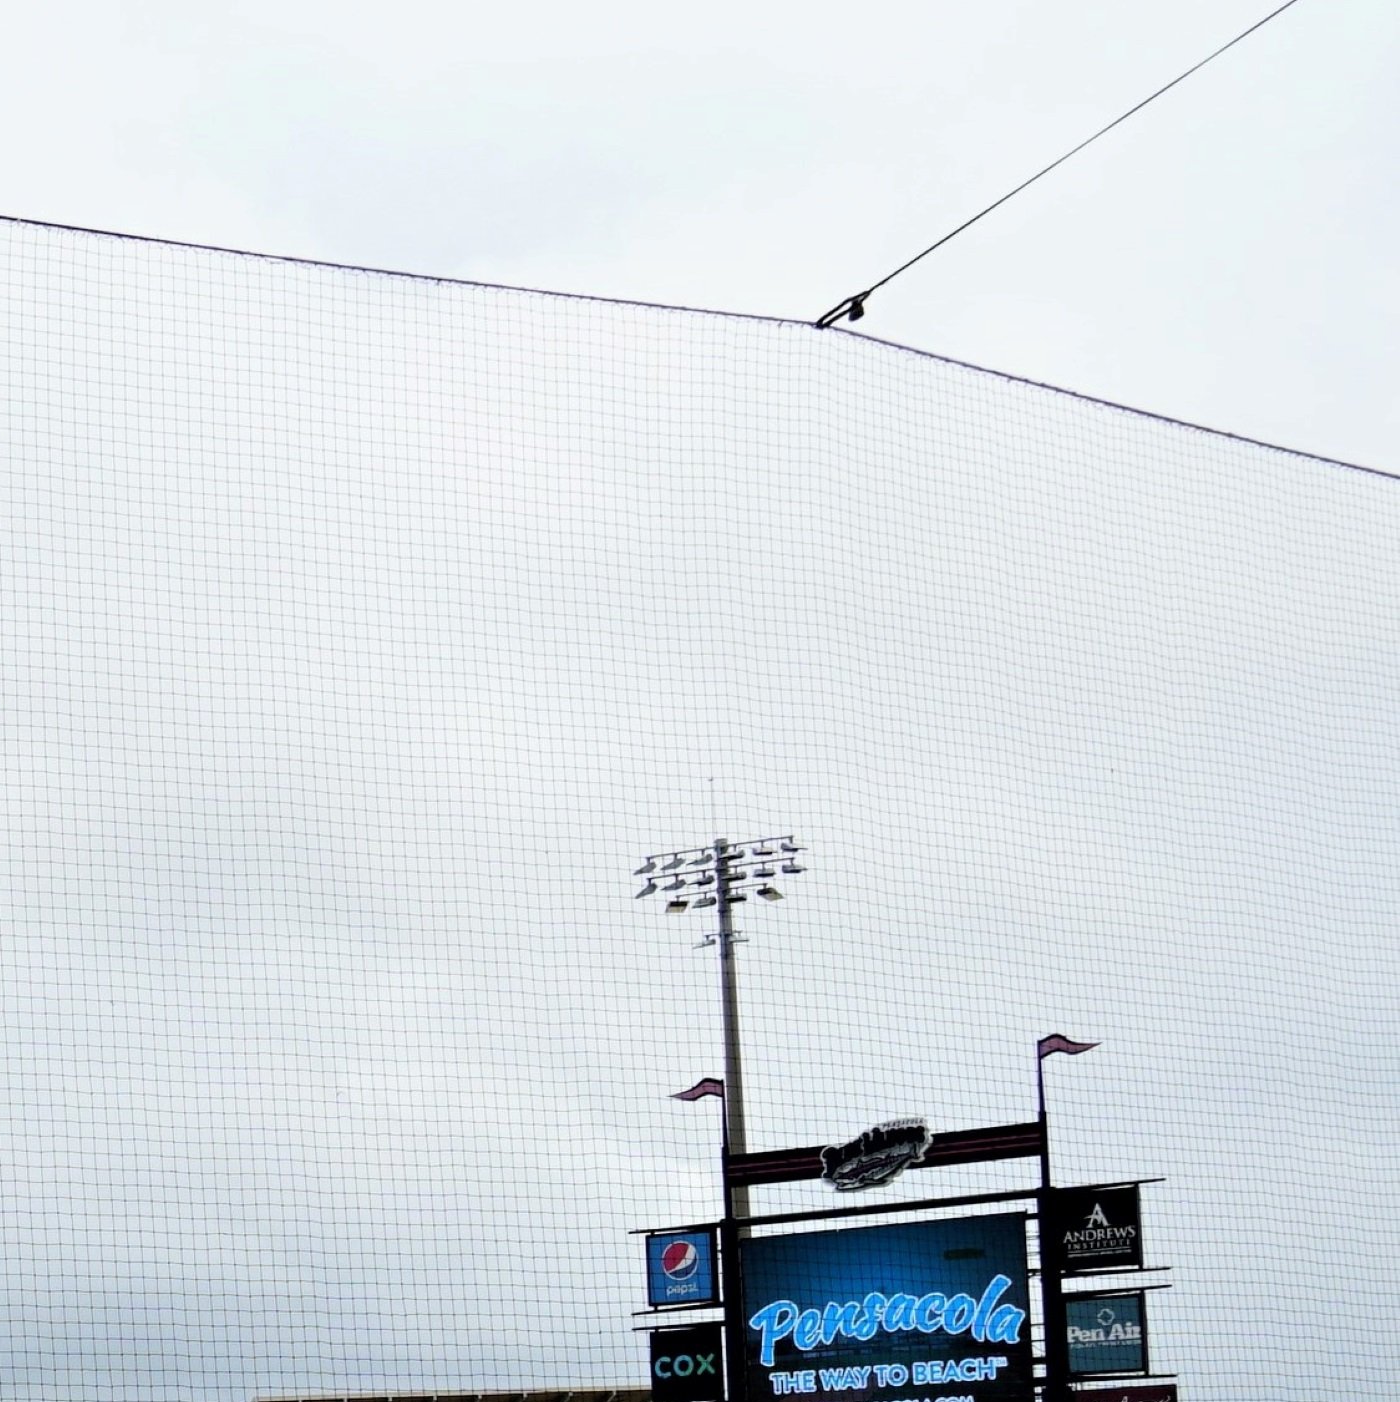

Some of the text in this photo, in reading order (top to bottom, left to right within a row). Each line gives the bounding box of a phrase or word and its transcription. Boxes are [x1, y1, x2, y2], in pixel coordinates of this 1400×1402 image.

[1063, 1225, 1137, 1244] ANDREWS
[1067, 1239, 1131, 1250] INSTITUTE
[666, 1283, 699, 1296] pepsi
[750, 1274, 1026, 1366] Pensacola
[1066, 1322, 1142, 1343] Pen Air
[655, 1353, 715, 1378] COX
[769, 1369, 817, 1395] THE
[819, 1366, 874, 1392] WAY
[875, 1364, 909, 1388] TO
